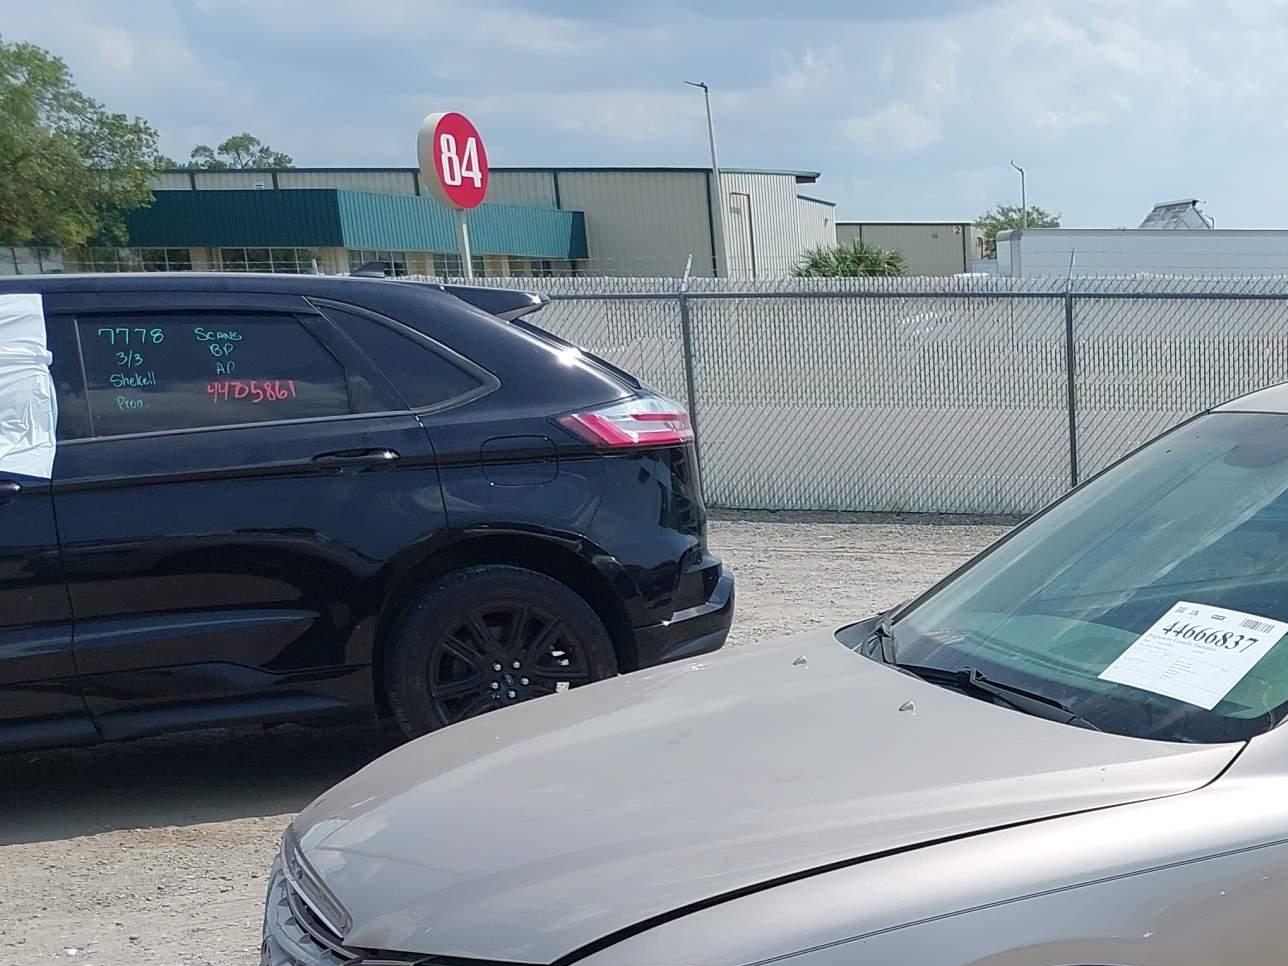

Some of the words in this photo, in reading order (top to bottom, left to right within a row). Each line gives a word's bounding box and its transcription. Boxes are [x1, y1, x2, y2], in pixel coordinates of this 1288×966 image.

[440, 132, 483, 189] 84
[97, 327, 165, 346] 7778
[115, 349, 144, 369] 3/3
[209, 342, 234, 357] BP
[216, 360, 236, 375] AP
[1162, 620, 1260, 653] 44666837
